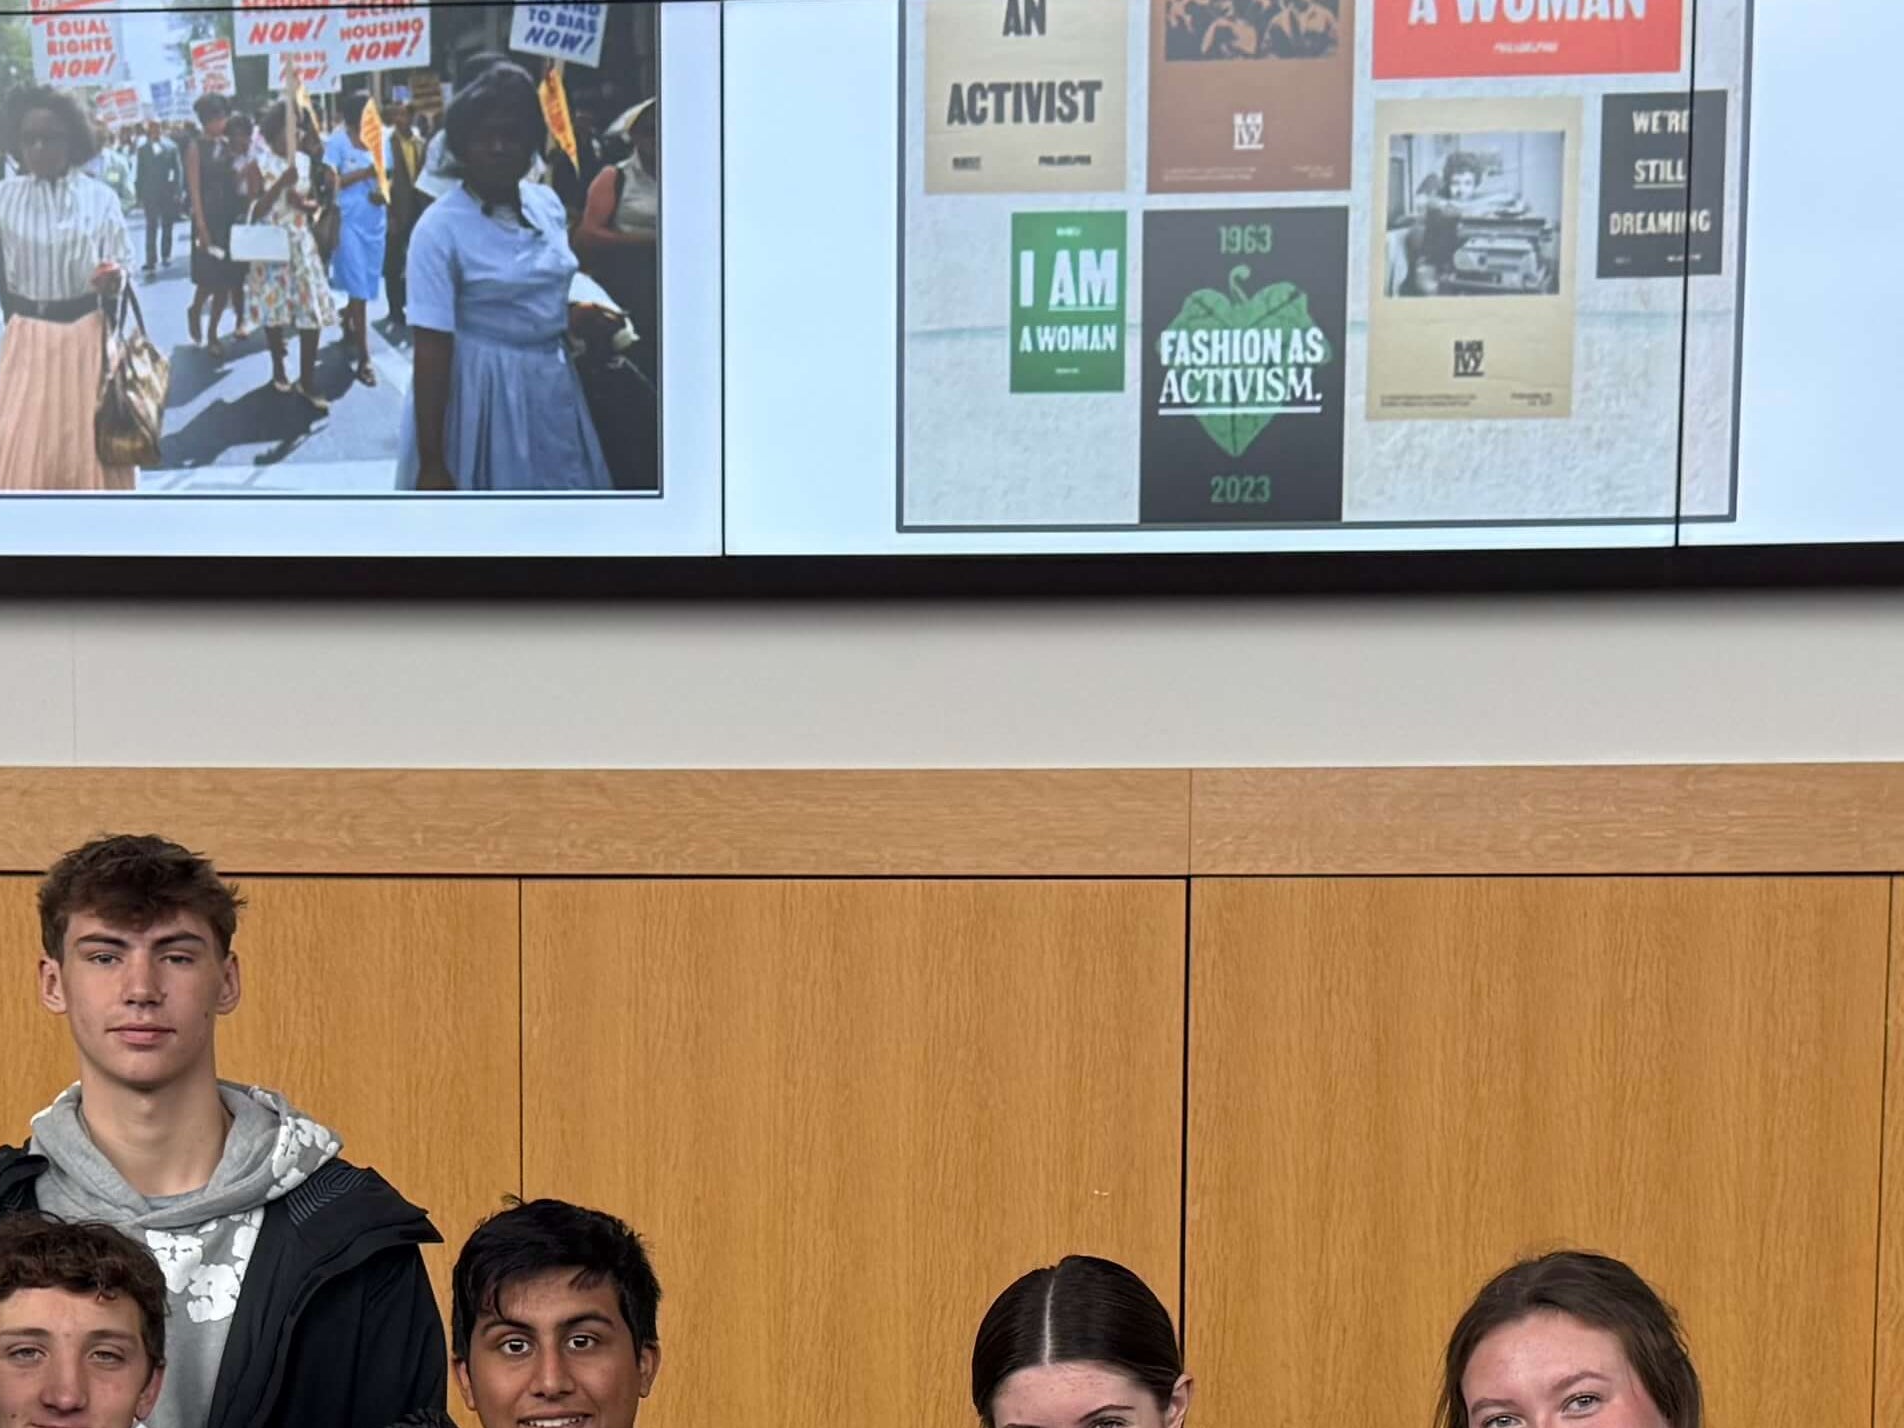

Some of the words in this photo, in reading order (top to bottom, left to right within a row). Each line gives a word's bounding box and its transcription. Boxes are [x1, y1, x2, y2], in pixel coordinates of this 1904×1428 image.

[47, 19, 109, 37] EQUAL
[249, 15, 328, 45] NOW!
[340, 17, 424, 41] HOUSING
[528, 8, 551, 23] TO
[556, 12, 598, 33] BIAS
[1002, 0, 1046, 36] AN
[47, 37, 113, 56] RIGHTS
[347, 34, 421, 63] NOW!
[524, 25, 594, 54] NOW!
[50, 53, 116, 79] NOW!
[947, 80, 1102, 125] ACTIVIST
[1634, 159, 1686, 183] STILL
[1609, 209, 1712, 236] DREAMING
[1219, 224, 1272, 254] 1963
[1020, 250, 1034, 307] I
[1048, 249, 1118, 307] AM
[1020, 326, 1032, 352] A
[1036, 325, 1117, 352] WOMAN
[1160, 329, 1282, 366] FASHION
[1287, 327, 1325, 364] AS
[1159, 367, 1322, 404] ACTIVISM.
[1211, 476, 1271, 502] 2023
